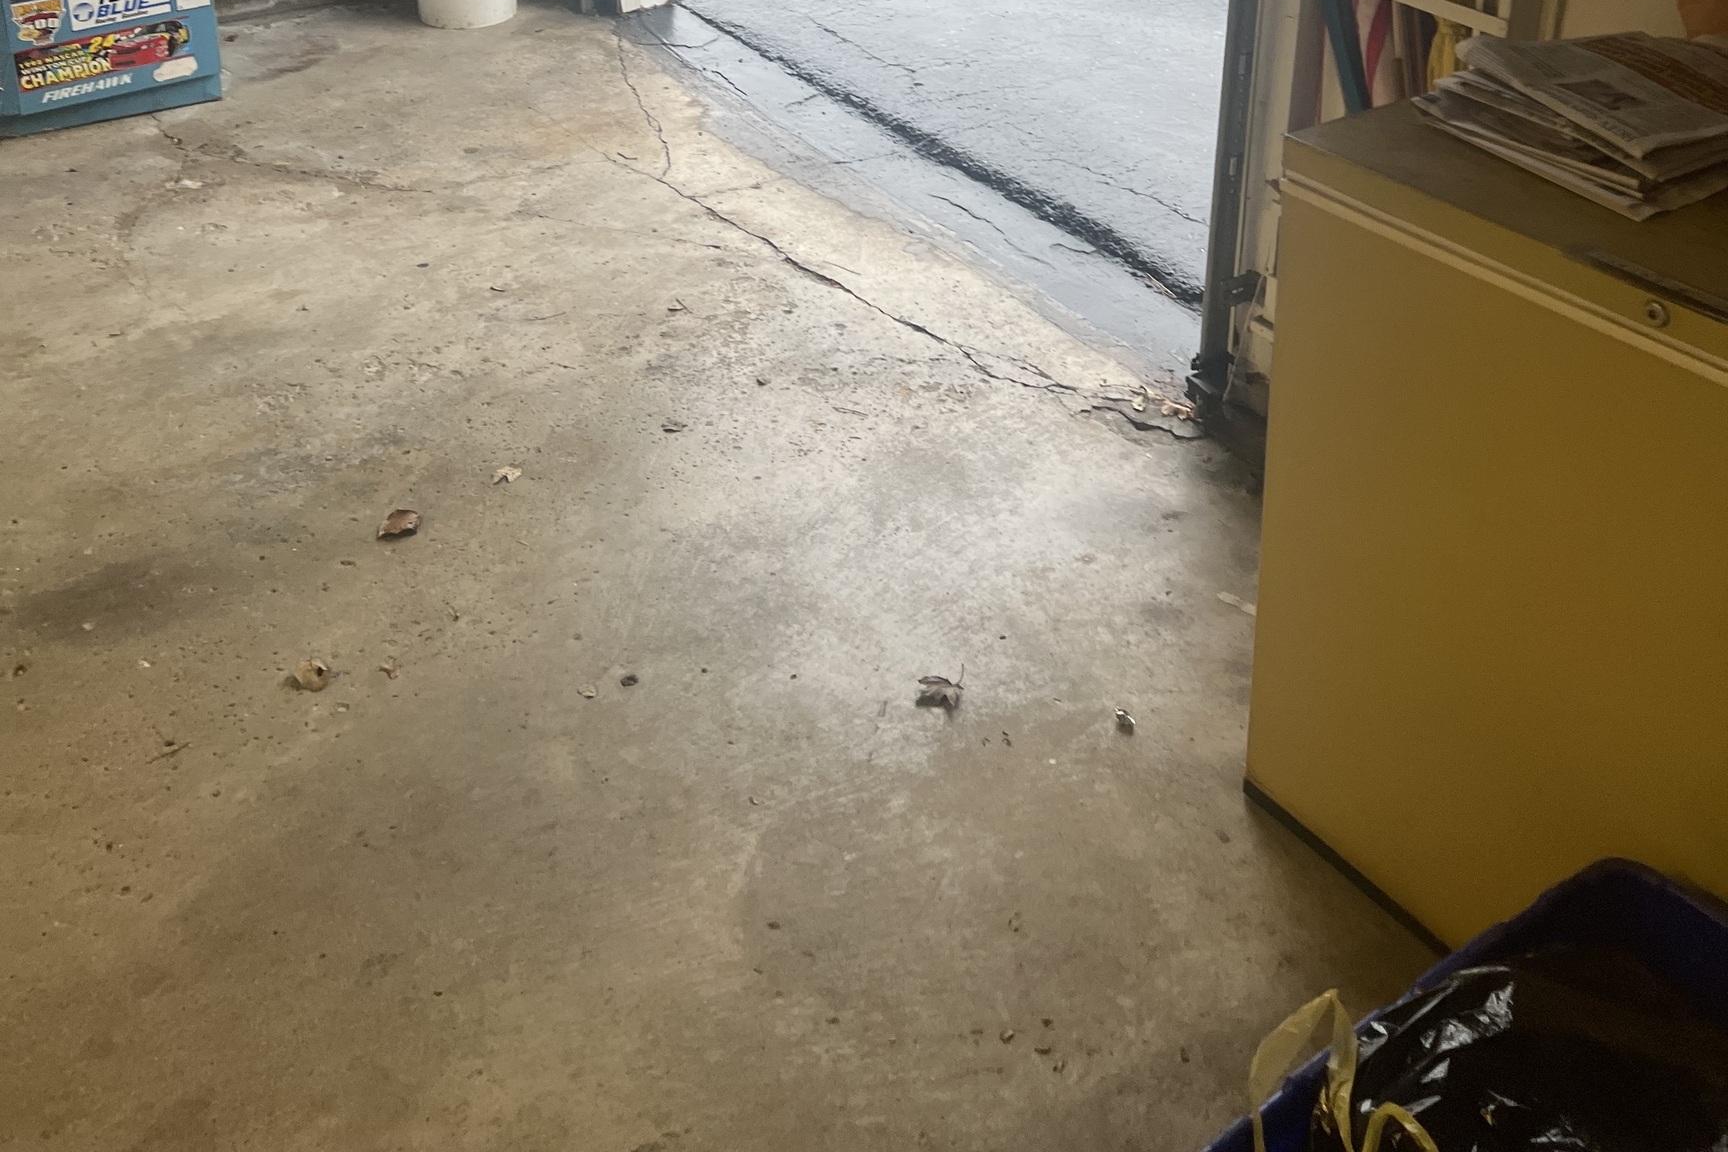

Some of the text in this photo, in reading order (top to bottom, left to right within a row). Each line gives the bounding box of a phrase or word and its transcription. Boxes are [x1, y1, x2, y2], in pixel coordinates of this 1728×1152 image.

[88, 33, 116, 54] 24
[20, 57, 112, 90] CHAMPION
[41, 73, 133, 103] FIREHAWK
